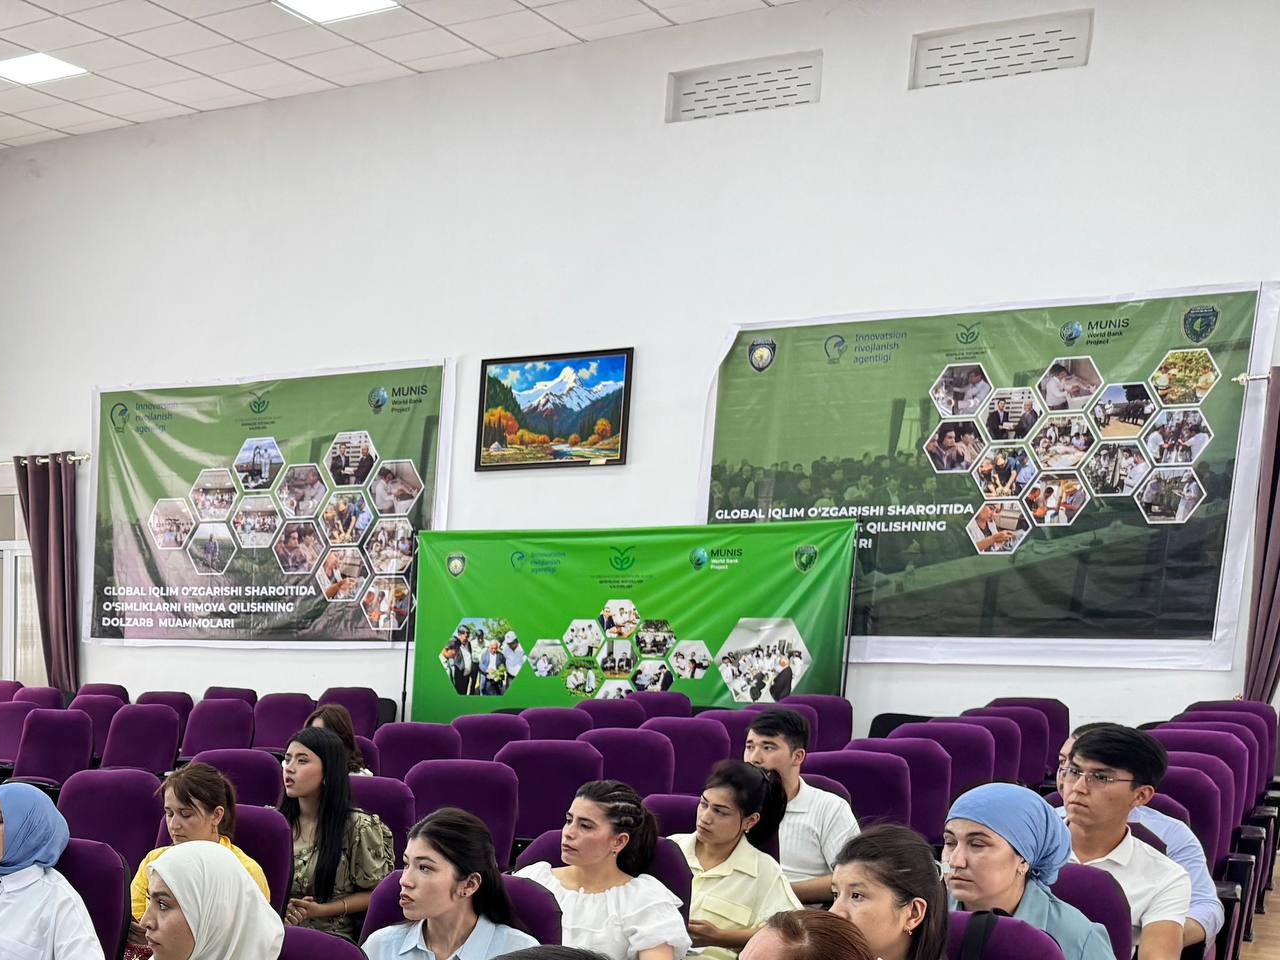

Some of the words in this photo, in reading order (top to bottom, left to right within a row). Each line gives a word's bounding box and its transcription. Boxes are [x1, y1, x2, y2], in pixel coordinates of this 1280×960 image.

[1087, 318, 1130, 331] MUNIS
[855, 330, 907, 342] Innovatsion
[1087, 331, 1106, 339] World
[854, 342, 899, 353] rivojlanish
[853, 353, 891, 365] agentligi
[391, 384, 428, 397] MUNIS
[715, 508, 765, 520] GLOBAL
[768, 508, 805, 520] IQLIM
[887, 504, 974, 516] SHAROITIDA
[866, 521, 947, 534] QILISHNING
[710, 548, 743, 557] MUNIS
[104, 586, 146, 596] GLOBAL
[149, 586, 178, 598] IQLIM
[244, 585, 316, 596] SHAROITIDA
[184, 602, 226, 612] HIMOYA
[228, 602, 295, 614] QILISHNING
[102, 617, 153, 627] DOLZARB
[159, 618, 234, 628] MUAMMOLARI
